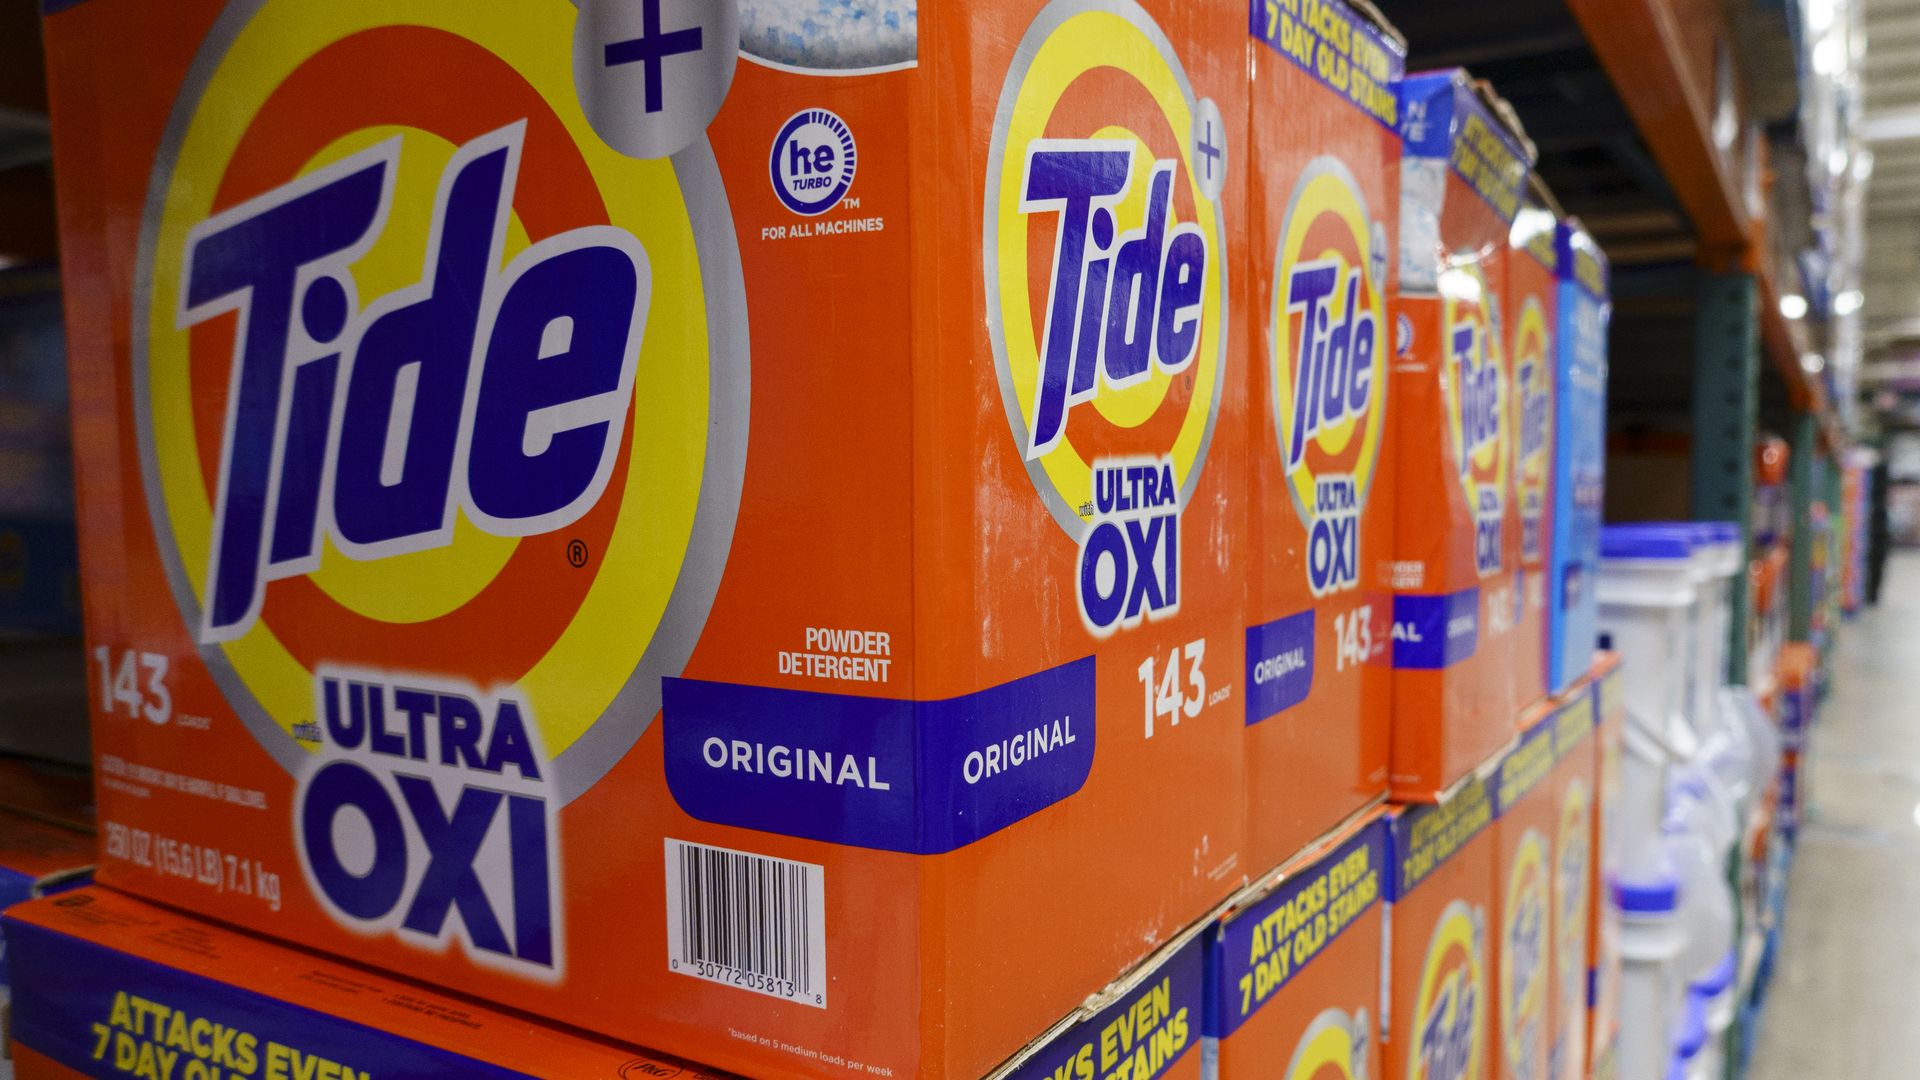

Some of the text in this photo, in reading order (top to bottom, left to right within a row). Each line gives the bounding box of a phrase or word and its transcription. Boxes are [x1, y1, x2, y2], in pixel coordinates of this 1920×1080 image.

[1266, 1, 1278, 40] 7
[1280, 11, 1315, 68] DAY
[1316, 42, 1349, 92] OLD
[1350, 67, 1397, 126] STAINS
[1278, 0, 1389, 83] TACKS EVEN
[790, 140, 834, 176] he
[793, 176, 832, 191] TURBO
[762, 217, 884, 240] FOR ALL MACHINES
[843, 198, 860, 209] TM
[1022, 145, 1206, 454] Tide
[182, 130, 645, 637] Tide
[1288, 263, 1375, 471] Tide
[1453, 326, 1498, 476] Tide
[1096, 464, 1176, 514] ULTRA
[1317, 481, 1356, 512] ULTRA
[1081, 514, 1177, 627] OXI
[1309, 515, 1357, 589] OXI
[778, 651, 891, 683] DETERGENT
[805, 627, 890, 656] POWDER
[1254, 647, 1306, 685] ORIGINAL
[1335, 604, 1372, 672] 143
[96, 646, 172, 725] 143
[1138, 638, 1206, 739] 143
[322, 677, 543, 781] ULTRA
[703, 737, 890, 790] ORIGINAL
[963, 715, 1076, 784] ORIGINAL
[224, 854, 252, 896] 7.1
[254, 861, 281, 912] kg
[303, 759, 553, 969] OXI
[1250, 843, 1369, 965] ATTACKS EVEN
[1239, 869, 1378, 1016] 7 DAY OLD STAINS
[672, 959, 822, 1004] 0 30772 05813 8
[92, 1022, 111, 1060] 7
[114, 1031, 179, 1080] DAY
[109, 990, 258, 1076] ATTACKS
[760, 1038, 770, 1047] on
[773, 1039, 778, 1049] 5
[781, 1042, 817, 1059] medium
[820, 1051, 845, 1066] loads
[847, 1060, 864, 1071] per
[867, 1064, 893, 1078] week
[1101, 976, 1170, 1074] EVEN
[1104, 1007, 1188, 1080] TAINS
